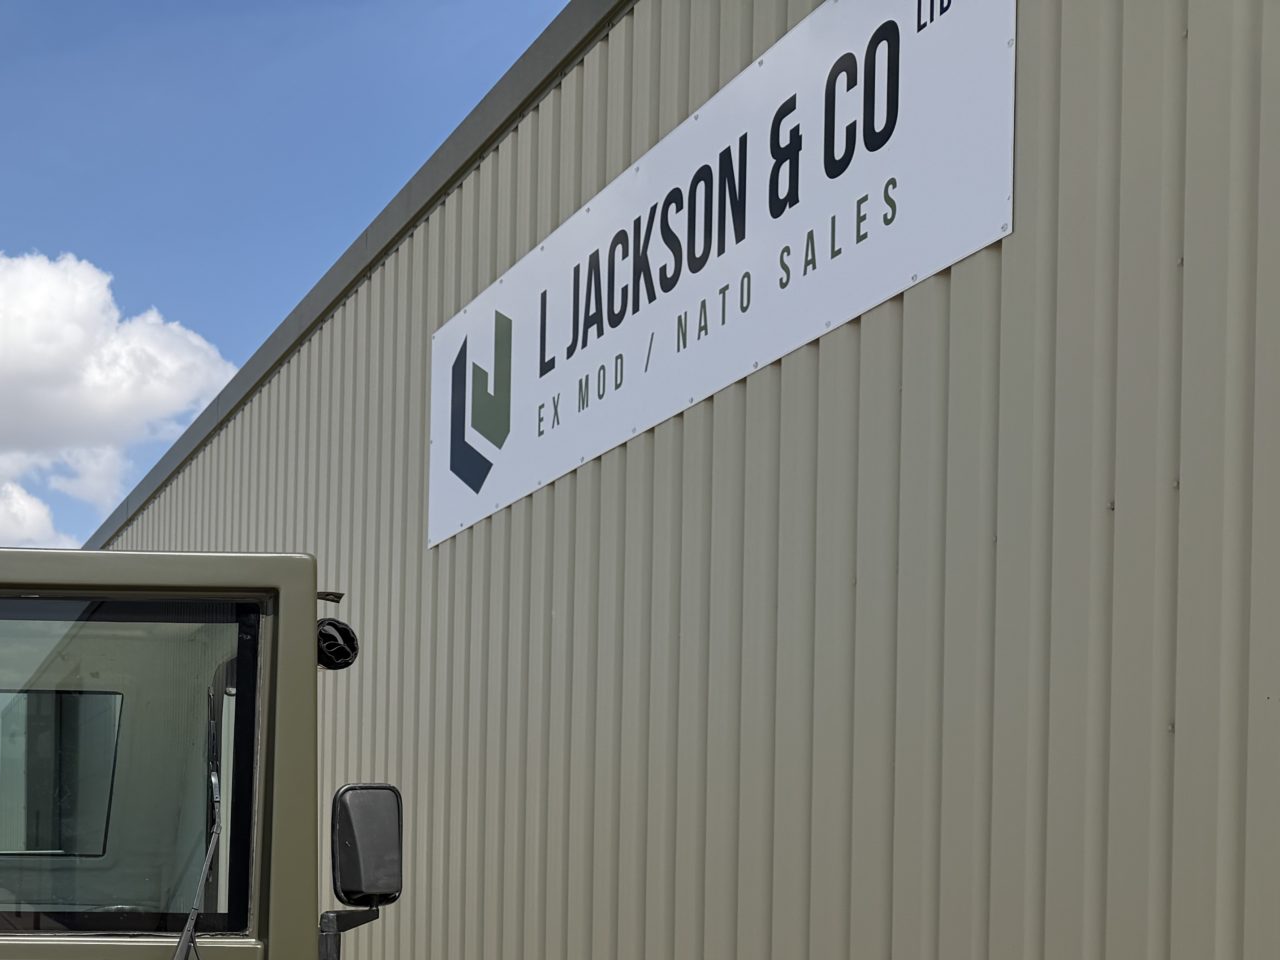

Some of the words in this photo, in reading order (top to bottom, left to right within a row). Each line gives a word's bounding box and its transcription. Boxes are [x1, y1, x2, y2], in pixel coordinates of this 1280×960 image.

[538, 393, 561, 437] EX
[578, 353, 624, 413] MOD
[677, 271, 752, 353] NATO
[779, 177, 898, 289] SALES
[539, 289, 556, 378] L
[566, 132, 748, 360] JACKSON
[769, 93, 802, 219] &
[824, 20, 900, 179] CO
